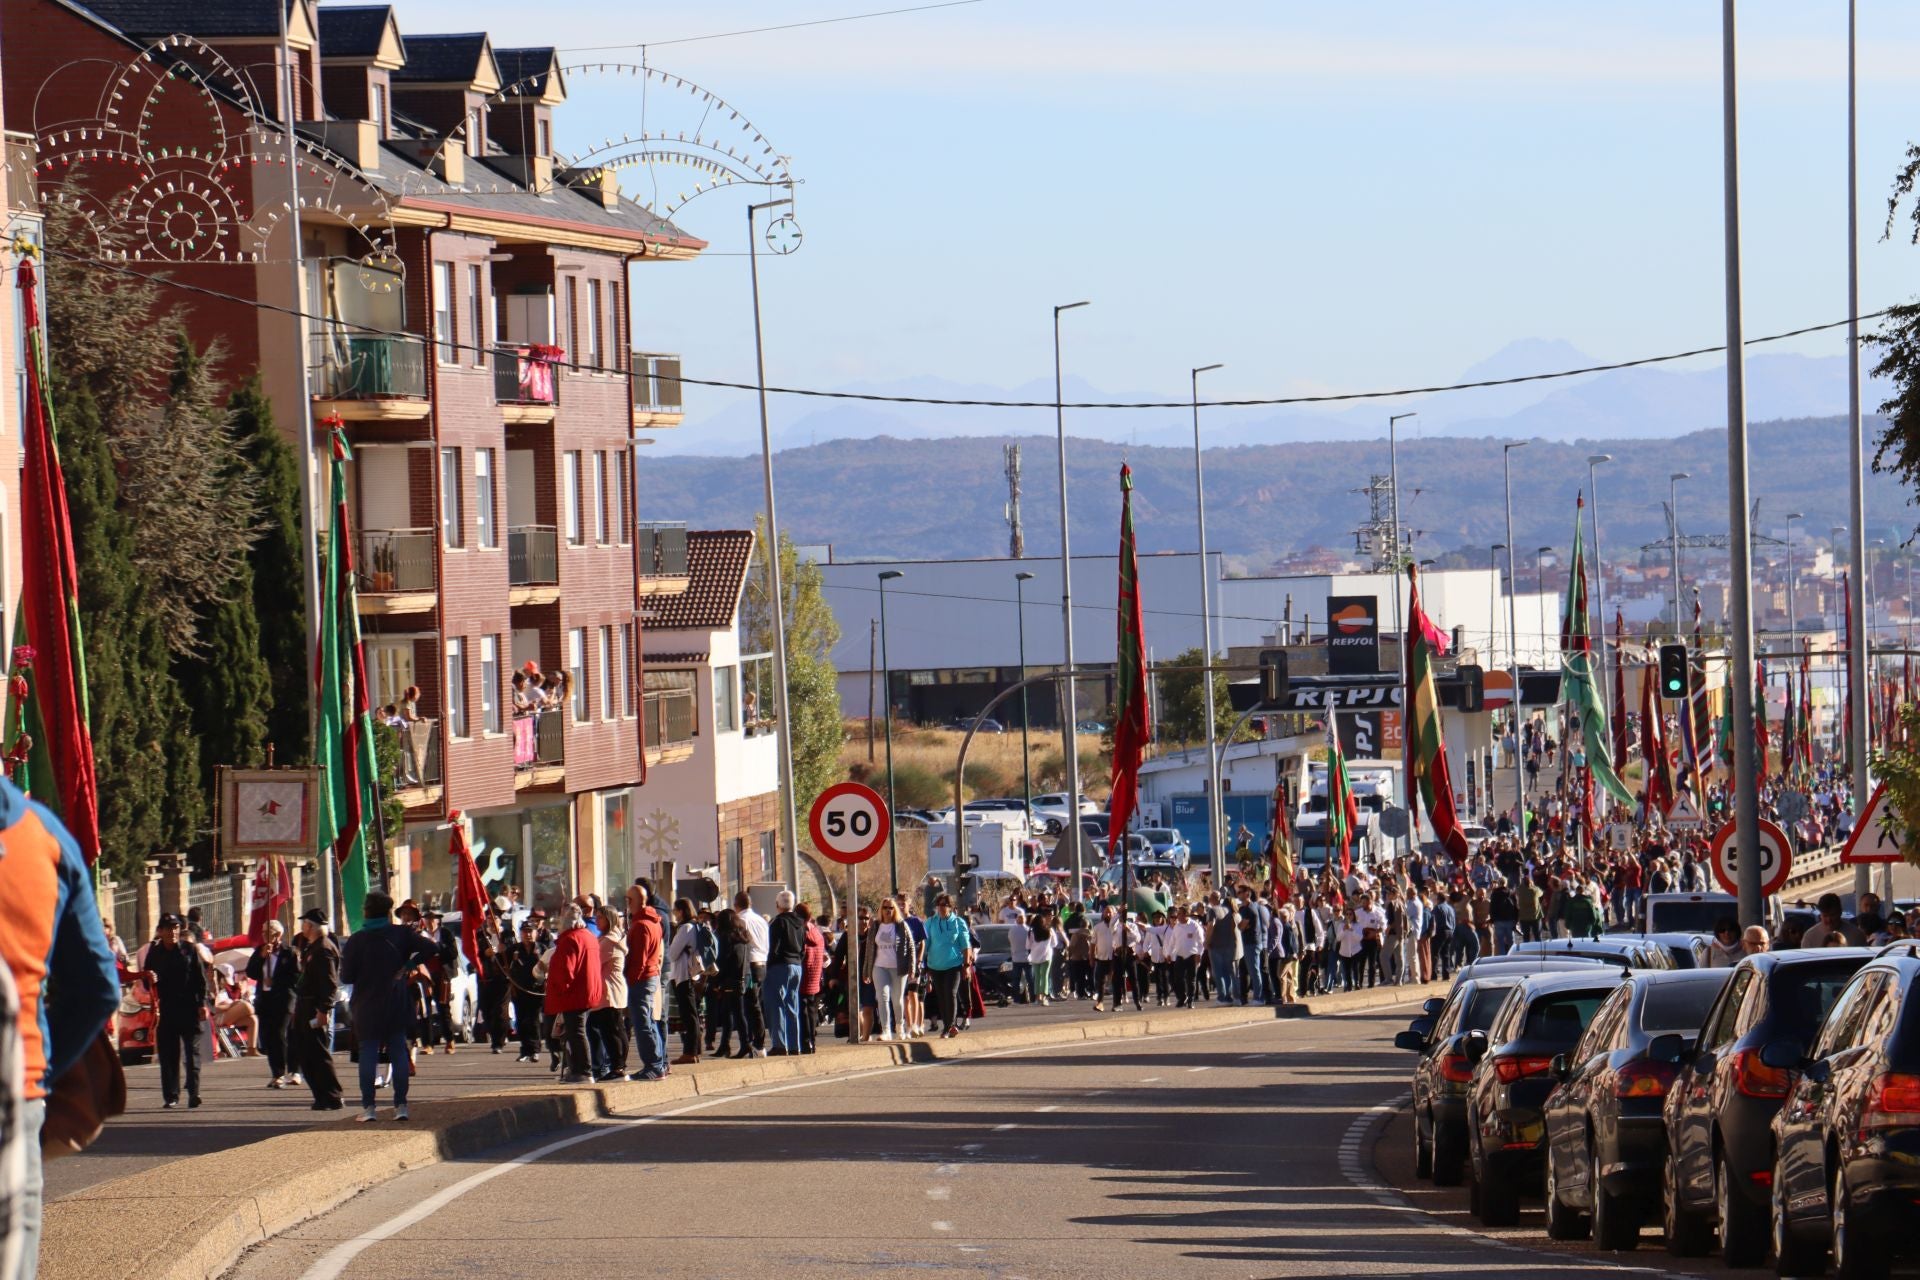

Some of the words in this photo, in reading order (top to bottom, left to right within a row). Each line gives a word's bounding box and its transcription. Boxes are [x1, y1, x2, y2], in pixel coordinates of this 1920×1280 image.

[1332, 637, 1374, 646] REPSOL
[1175, 805, 1195, 814] Blue
[827, 810, 872, 837] 50
